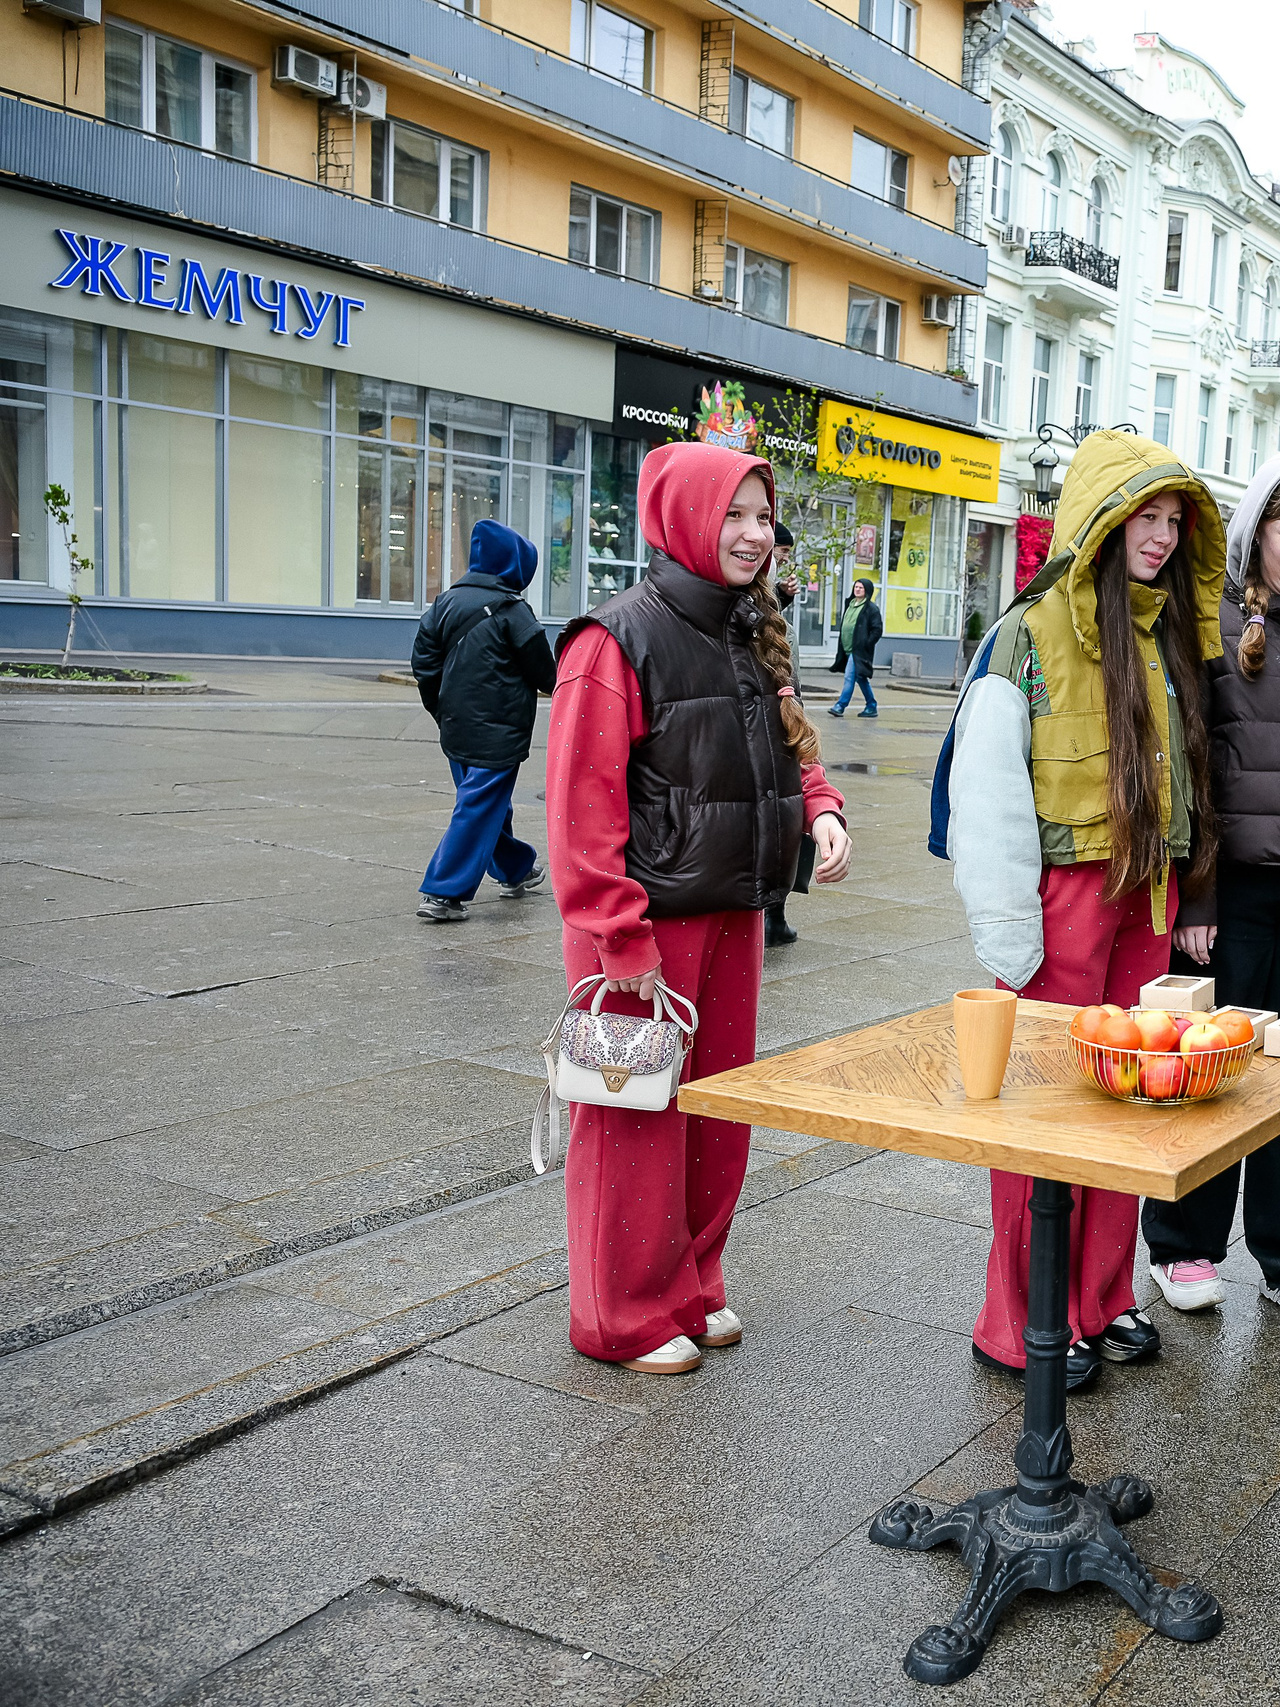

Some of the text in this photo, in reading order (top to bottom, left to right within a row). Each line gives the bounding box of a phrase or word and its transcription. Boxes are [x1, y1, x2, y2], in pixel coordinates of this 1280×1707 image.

[48, 228, 366, 348] ЖЕМЧУГ
[950, 454, 992, 470] Центр выплаты
[959, 468, 992, 480] выигрышей
